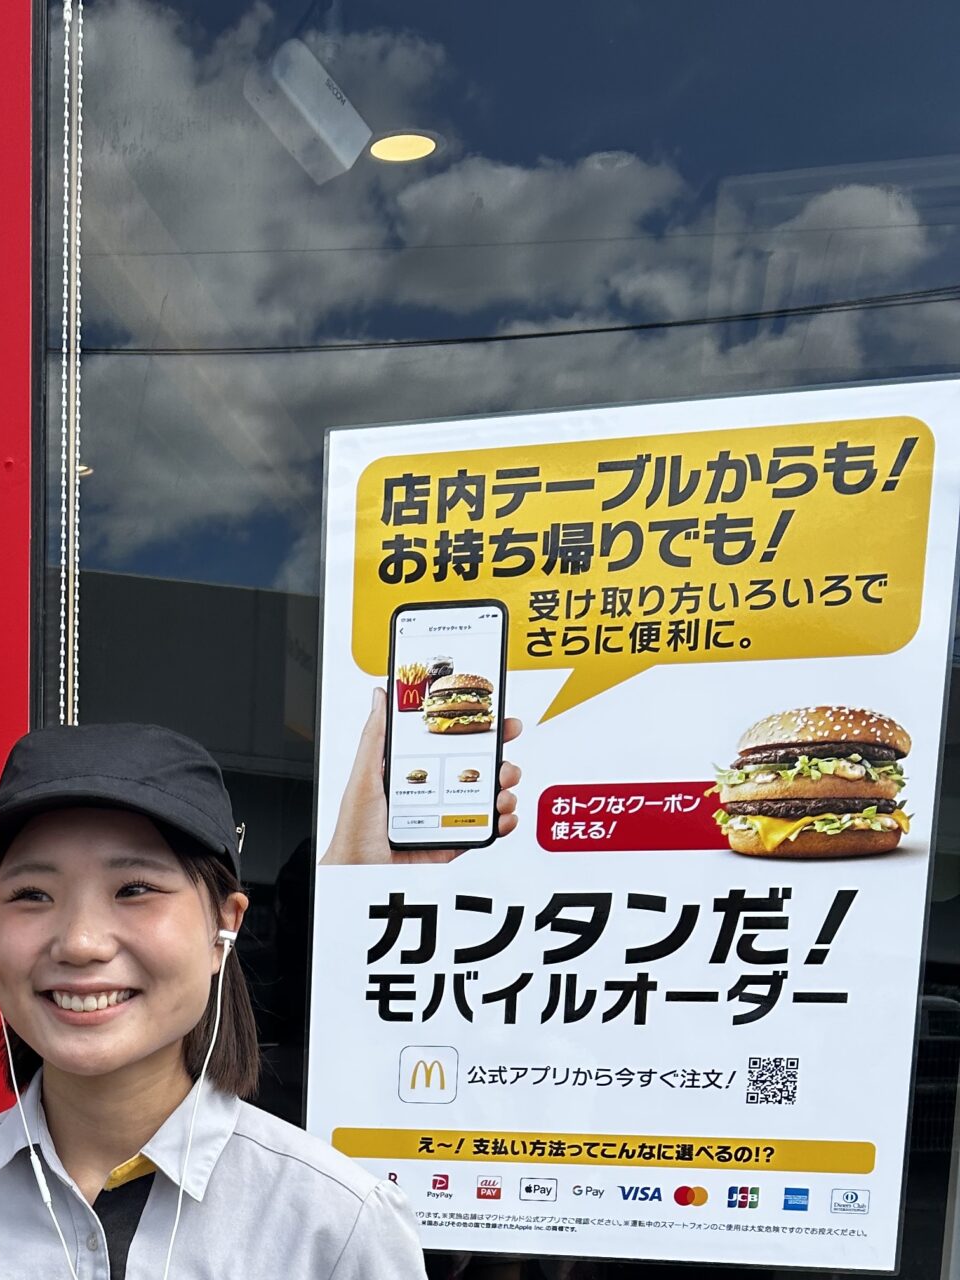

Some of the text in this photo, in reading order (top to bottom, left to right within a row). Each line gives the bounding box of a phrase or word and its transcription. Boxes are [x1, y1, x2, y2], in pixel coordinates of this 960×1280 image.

[381, 436, 919, 527] 店内テーブルからも!
[378, 508, 796, 585] お持ち帰りでも!
[528, 573, 889, 623] 受け取り方いろいろで
[526, 617, 752, 657] さらに便利に。
[551, 793, 701, 816] おトクなクーポン
[550, 820, 618, 841] 使える!
[366, 886, 859, 966] カンタンだ!
[365, 970, 849, 1026] モバイルオーダー
[467, 1065, 737, 1090] 公式アプリから今すぐ注文!
[426, 1191, 453, 1199] PayPay
[480, 1179, 499, 1187] au
[480, 1188, 498, 1196] PAY
[585, 1186, 605, 1199] Pay
[617, 1185, 662, 1202] VISA
